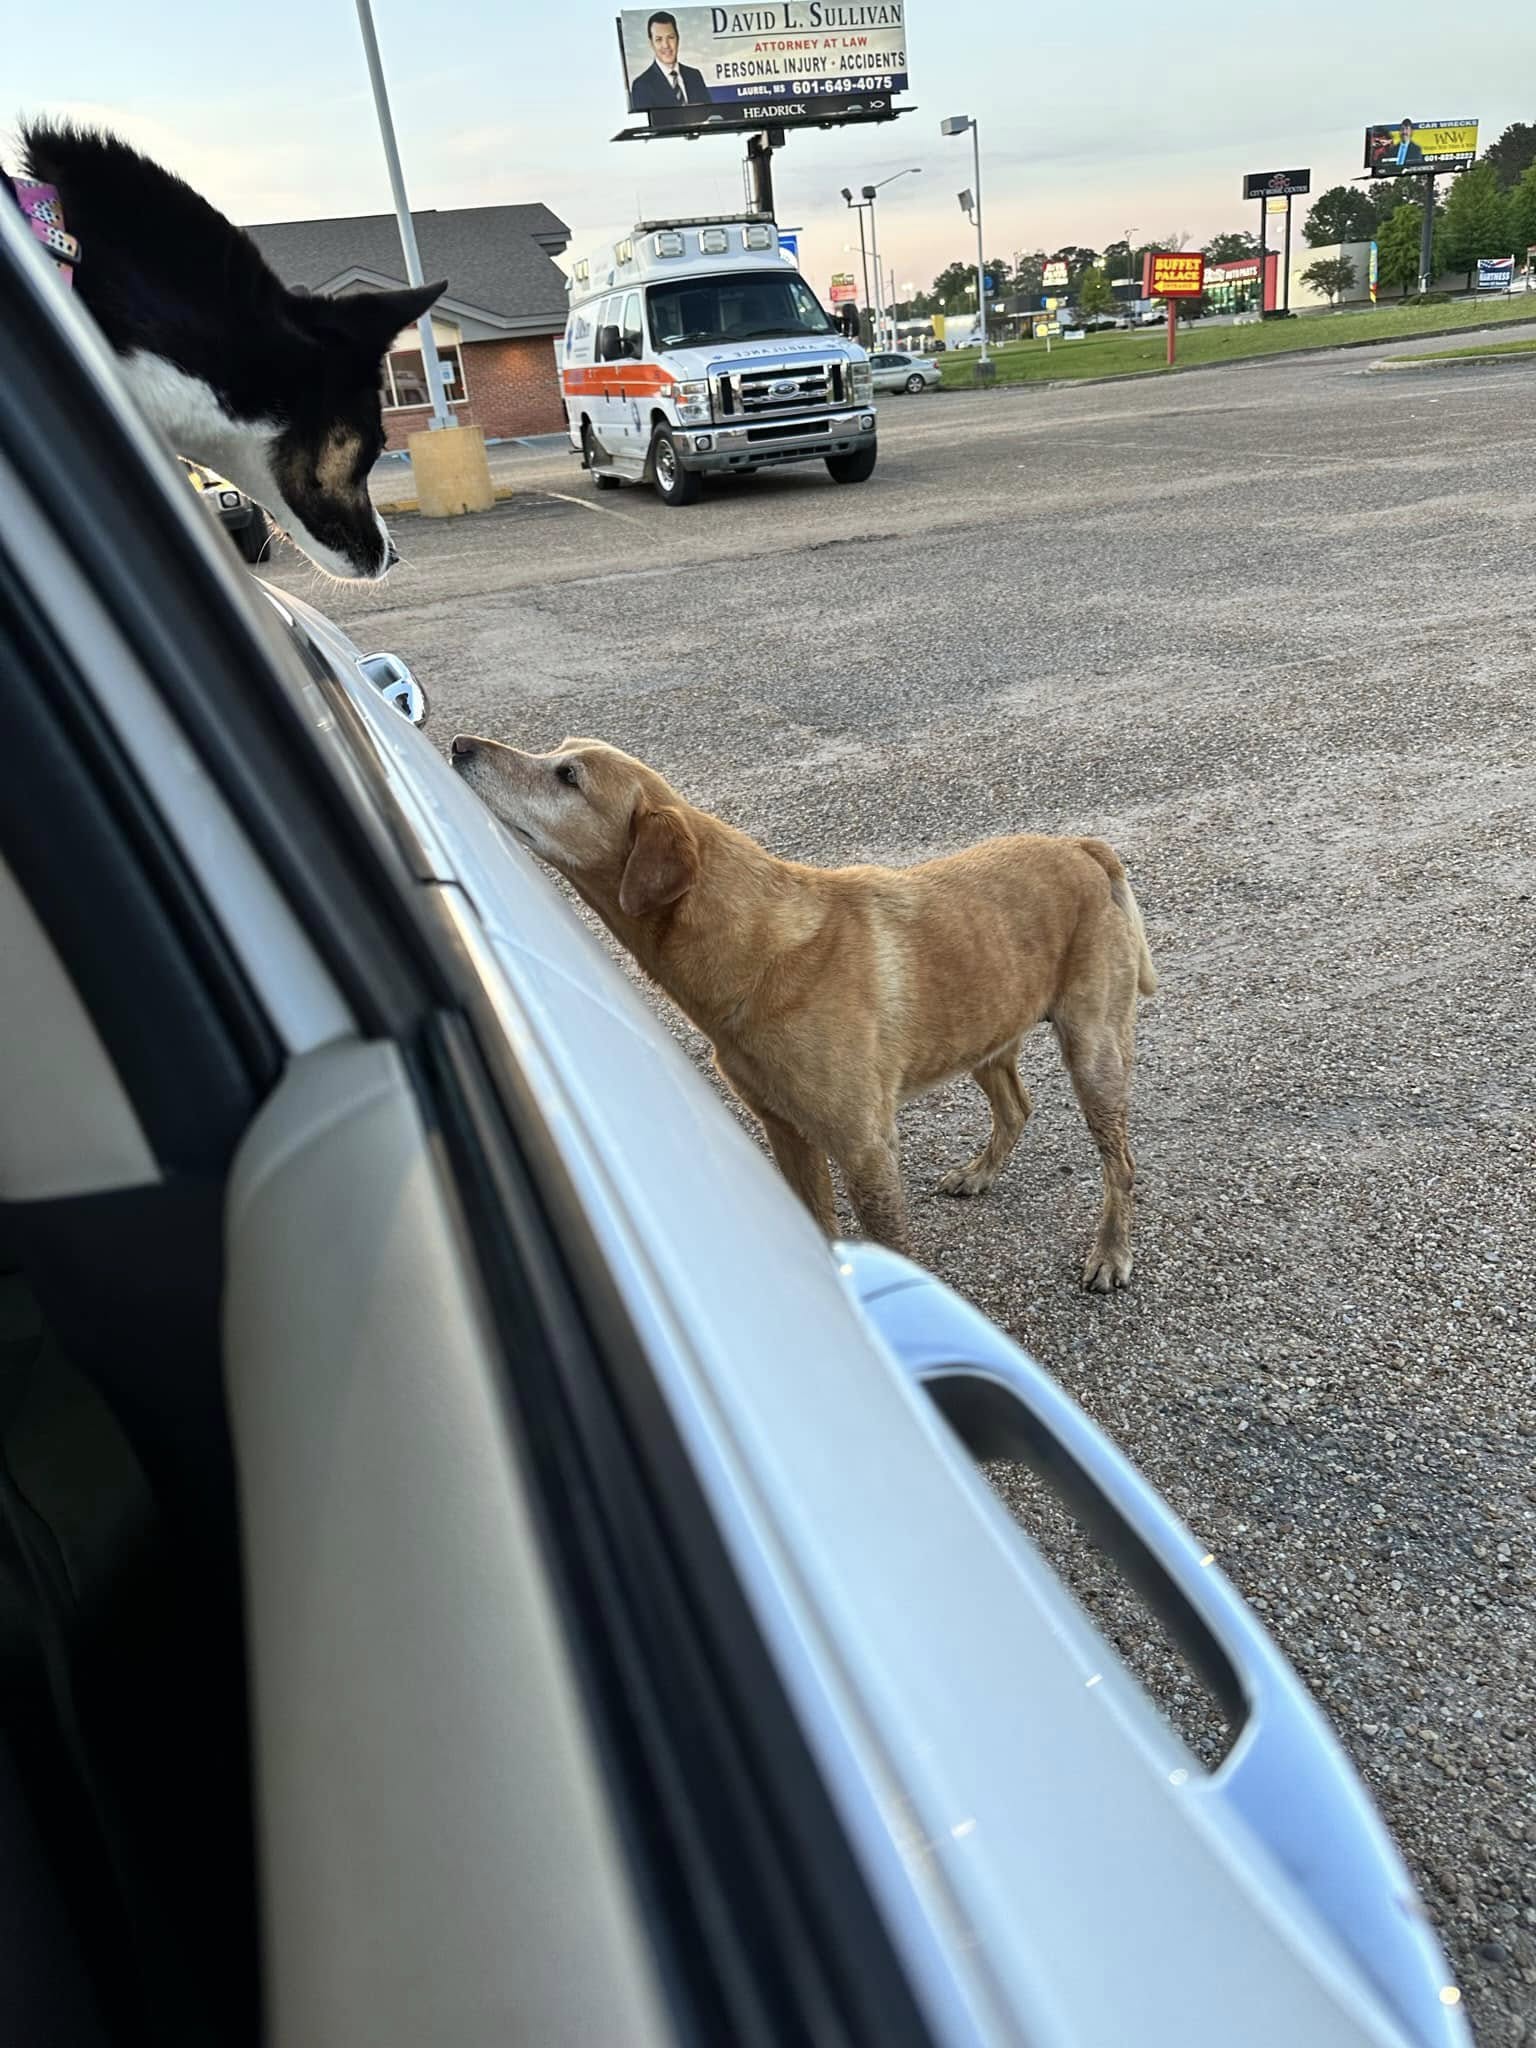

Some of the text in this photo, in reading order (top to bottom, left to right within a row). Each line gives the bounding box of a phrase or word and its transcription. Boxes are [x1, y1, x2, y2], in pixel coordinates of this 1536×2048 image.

[711, 2, 901, 33] DAVID L. SULLIVAN
[754, 37, 868, 52] ATTORNEY AT LAW
[716, 52, 905, 79] PERSONAL INJURY ACCIDENTS
[737, 85, 772, 96] LAUREL,
[792, 76, 893, 94] 601-649-4075
[743, 104, 806, 118] HEADRICK
[1155, 258, 1202, 270] BUFFET
[1155, 270, 1200, 281] PALACE
